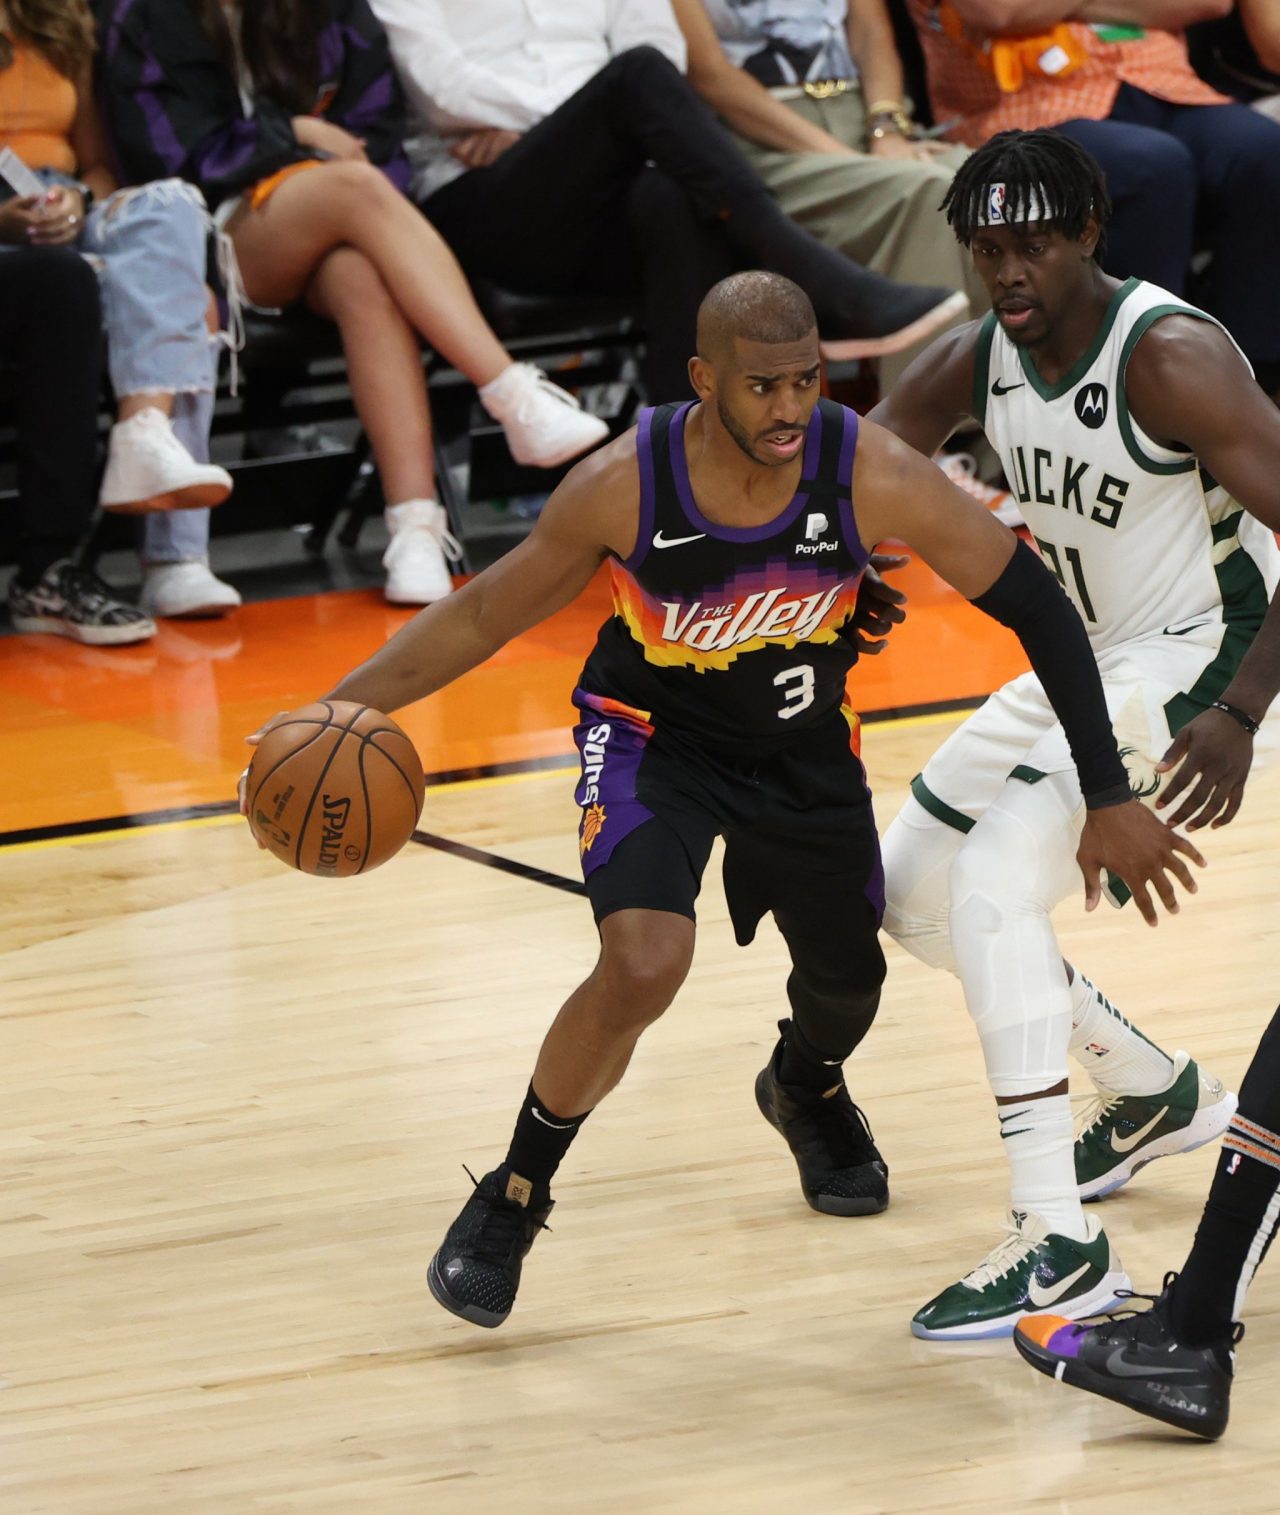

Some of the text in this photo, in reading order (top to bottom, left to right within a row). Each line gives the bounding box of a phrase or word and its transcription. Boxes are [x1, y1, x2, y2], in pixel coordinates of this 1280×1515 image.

[1009, 446, 1130, 529] UCKS
[795, 540, 839, 555] PayPal
[661, 583, 845, 651] THE Valley
[773, 664, 815, 720] 3
